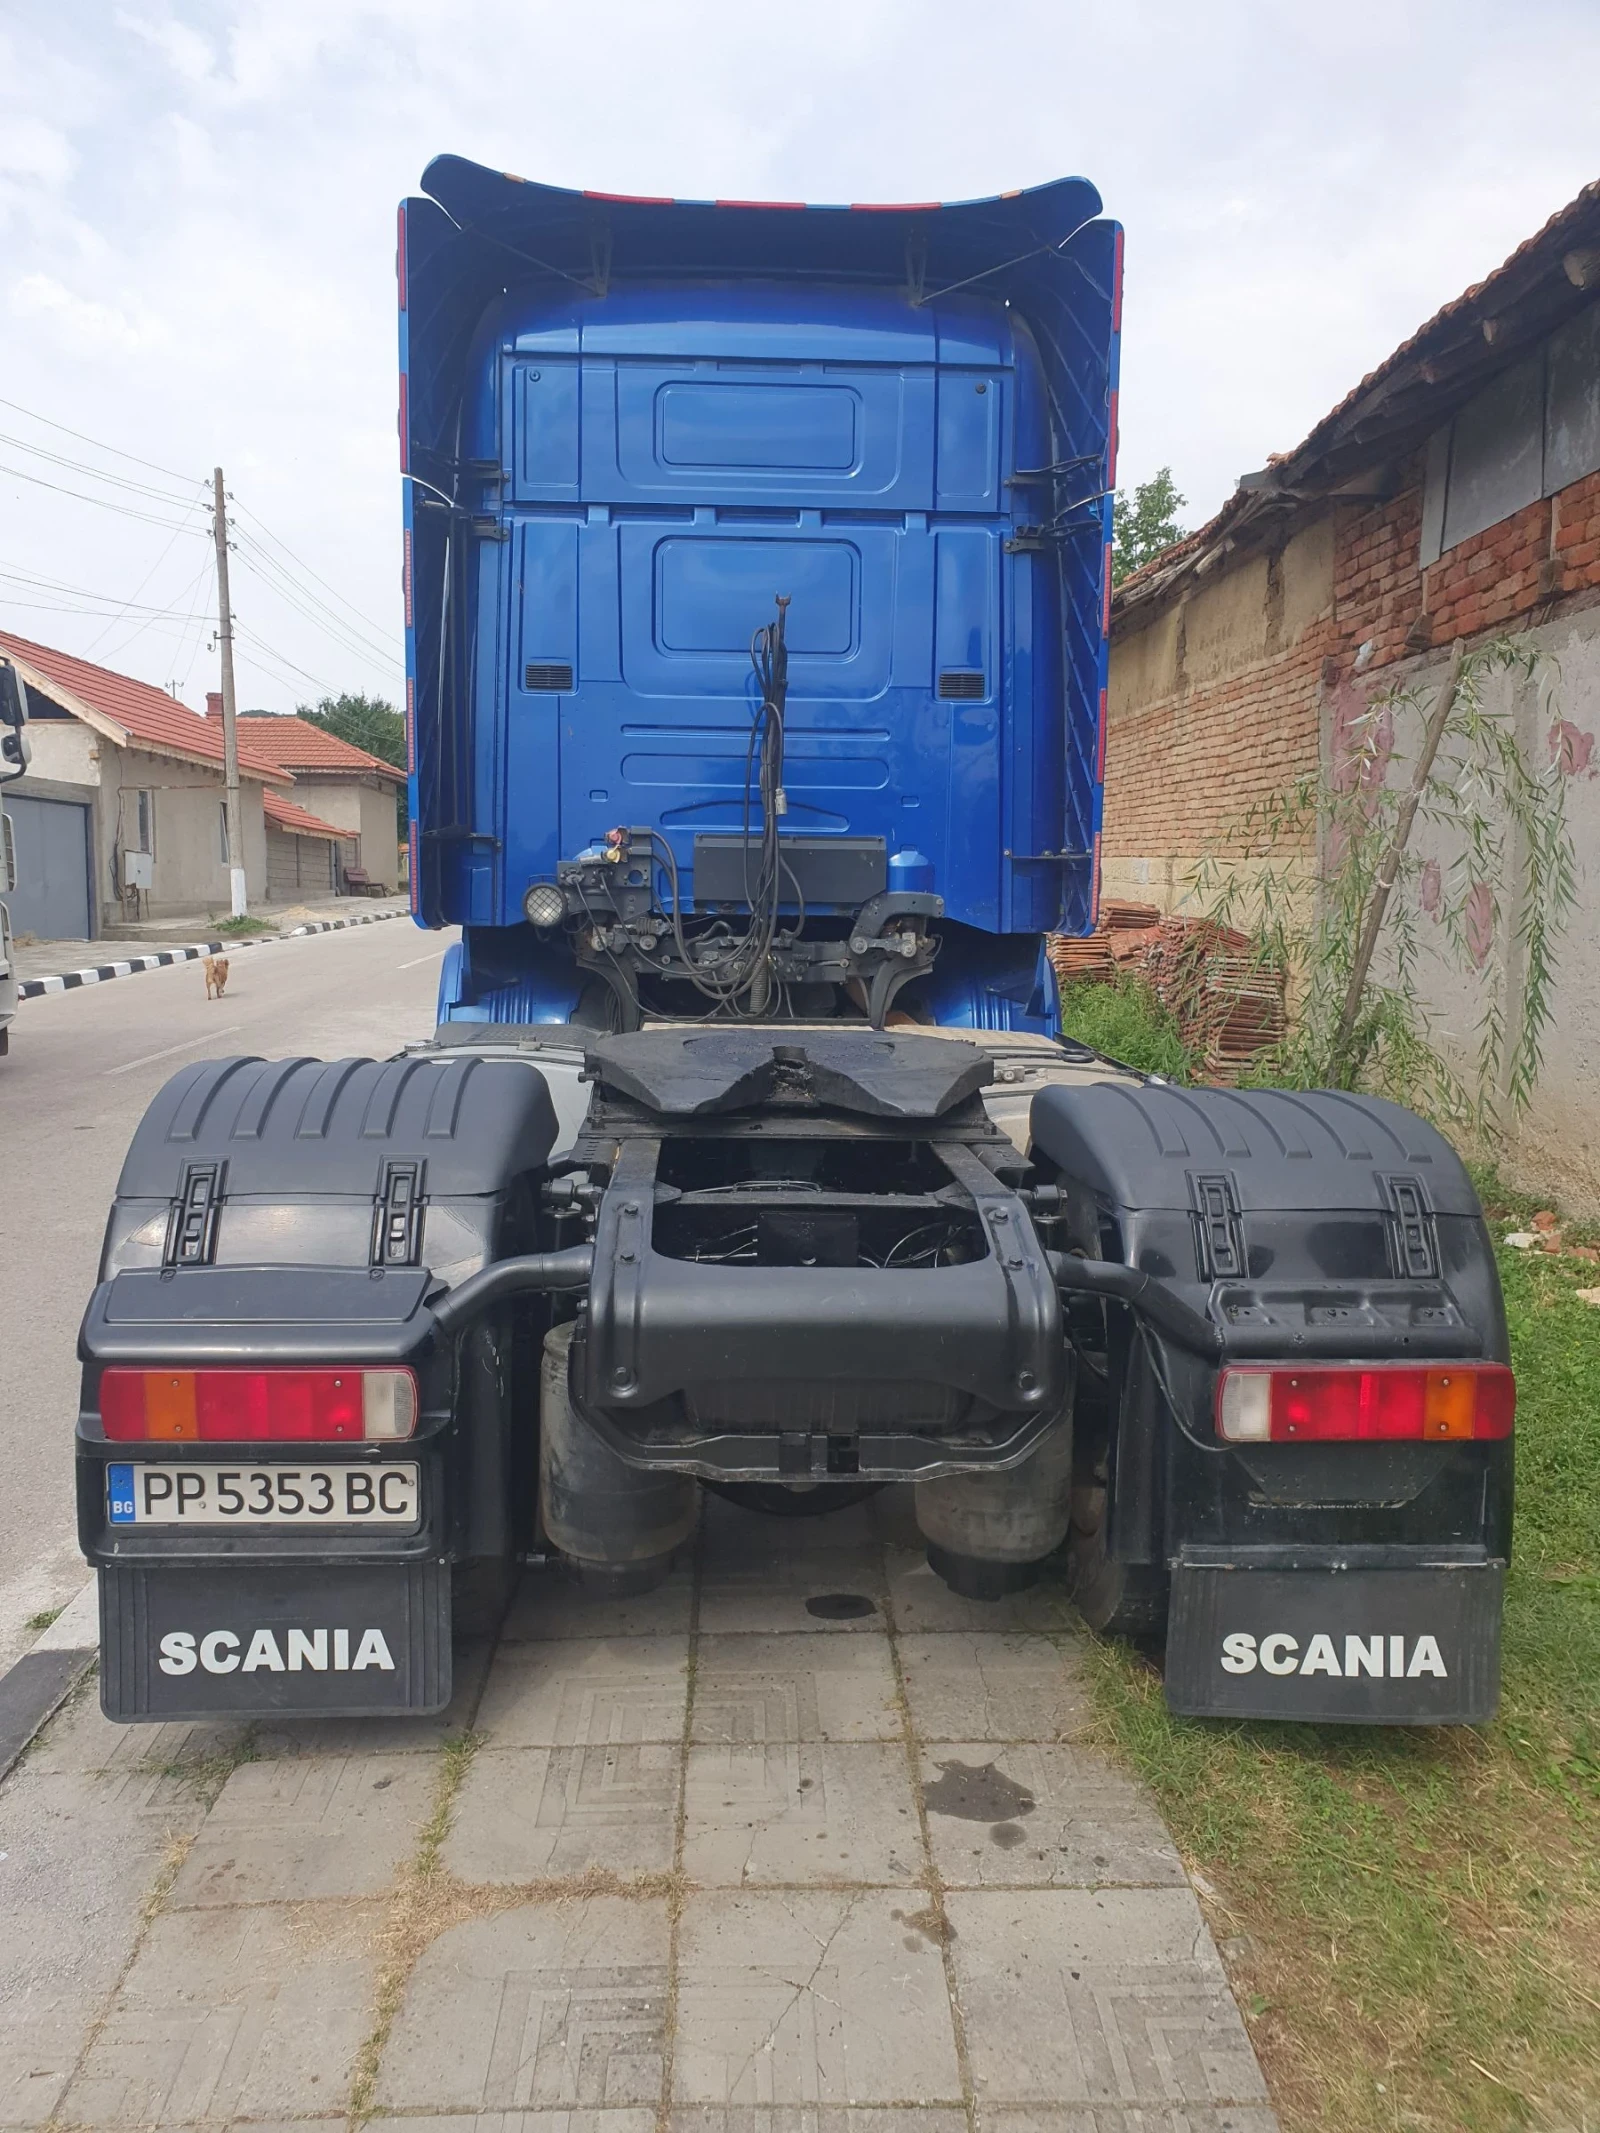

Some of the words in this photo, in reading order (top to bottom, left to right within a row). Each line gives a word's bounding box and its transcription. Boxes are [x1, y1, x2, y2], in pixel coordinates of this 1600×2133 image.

[112, 1501, 134, 1515] BG
[143, 1472, 206, 1515] PP
[217, 1472, 335, 1515] 5353
[346, 1471, 408, 1515] BC
[158, 1628, 396, 1676] SCANIA
[1220, 1632, 1449, 1678] SCANIA
